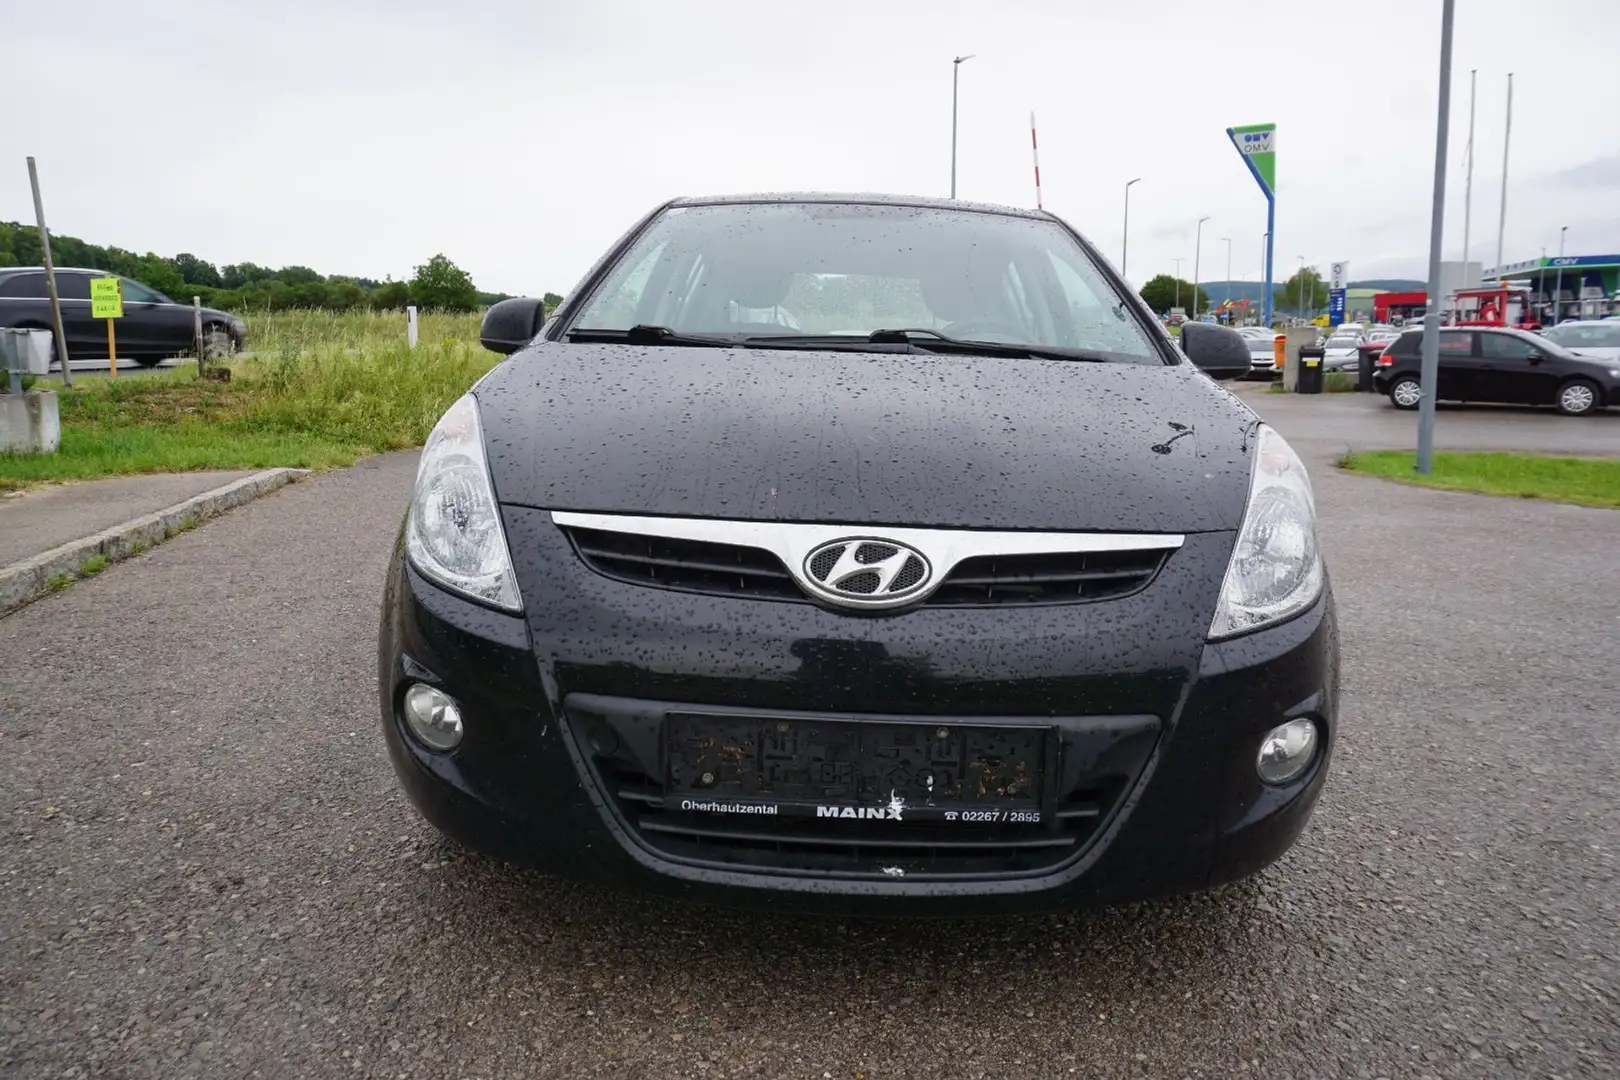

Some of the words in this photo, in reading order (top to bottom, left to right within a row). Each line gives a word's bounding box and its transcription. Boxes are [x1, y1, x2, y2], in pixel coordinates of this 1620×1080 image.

[1244, 143, 1270, 153] OMV
[681, 800, 778, 815] Oberhautzental
[961, 811, 1000, 821] 02267
[1010, 812, 1040, 822] 2895
